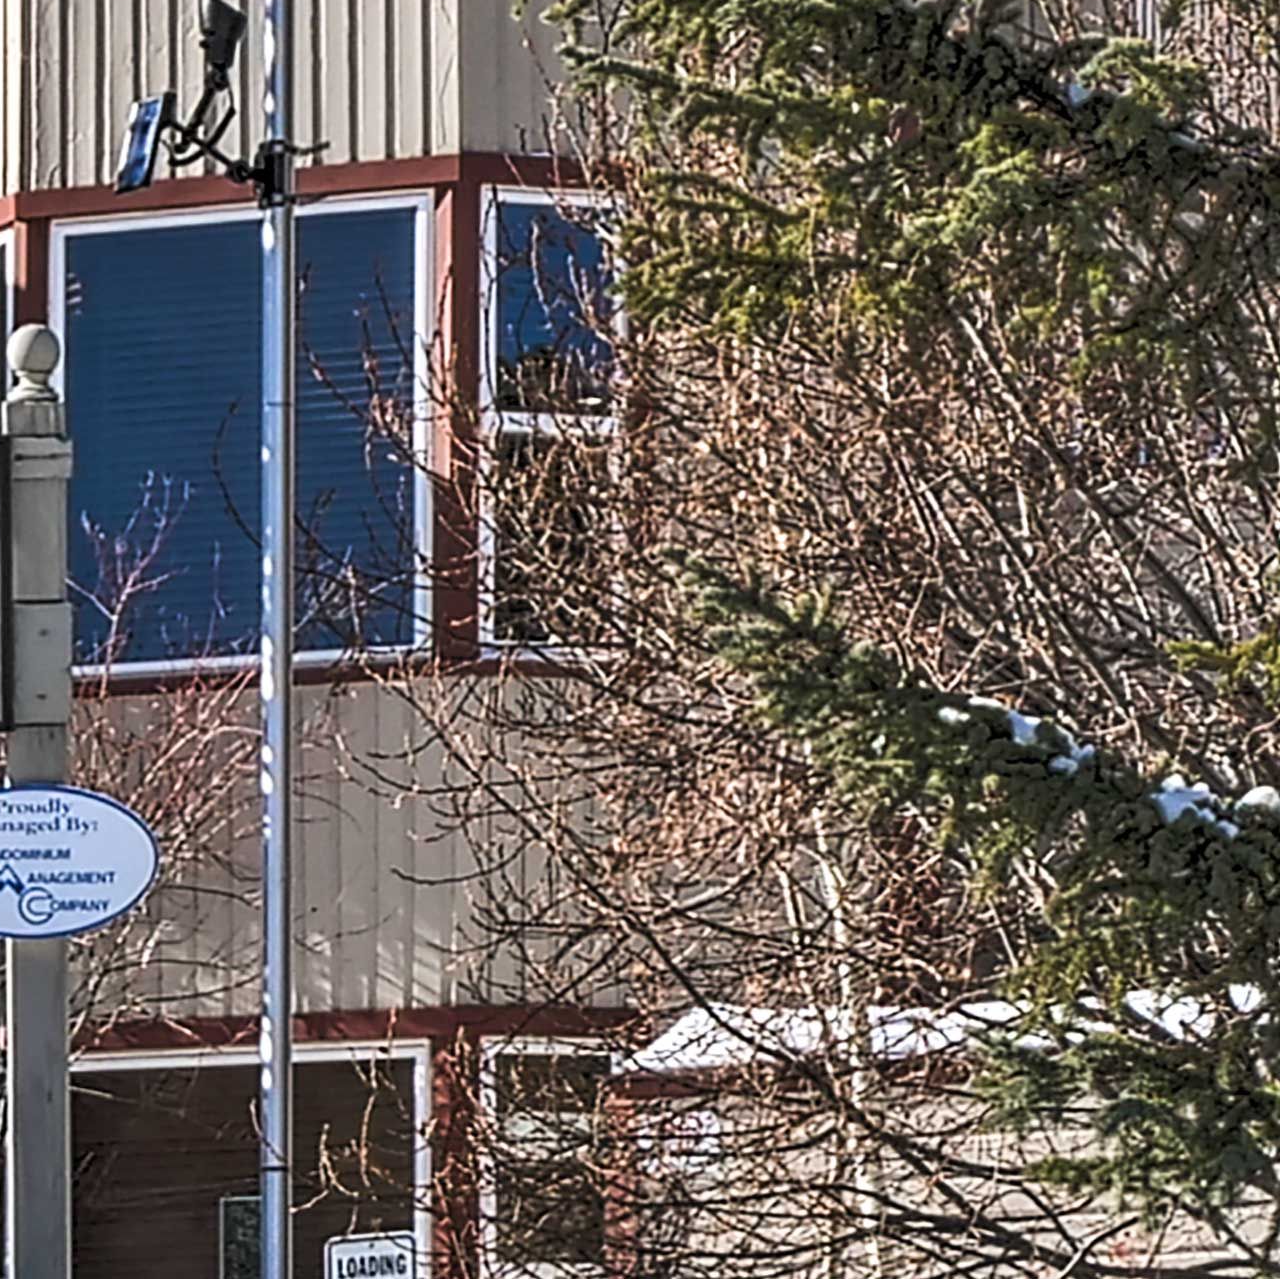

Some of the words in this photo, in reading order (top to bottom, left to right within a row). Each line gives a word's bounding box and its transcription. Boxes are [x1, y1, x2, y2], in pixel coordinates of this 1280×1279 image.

[66, 817, 99, 836] By:
[18, 886, 110, 926] COMPANY
[337, 1253, 407, 1278] LOADING
